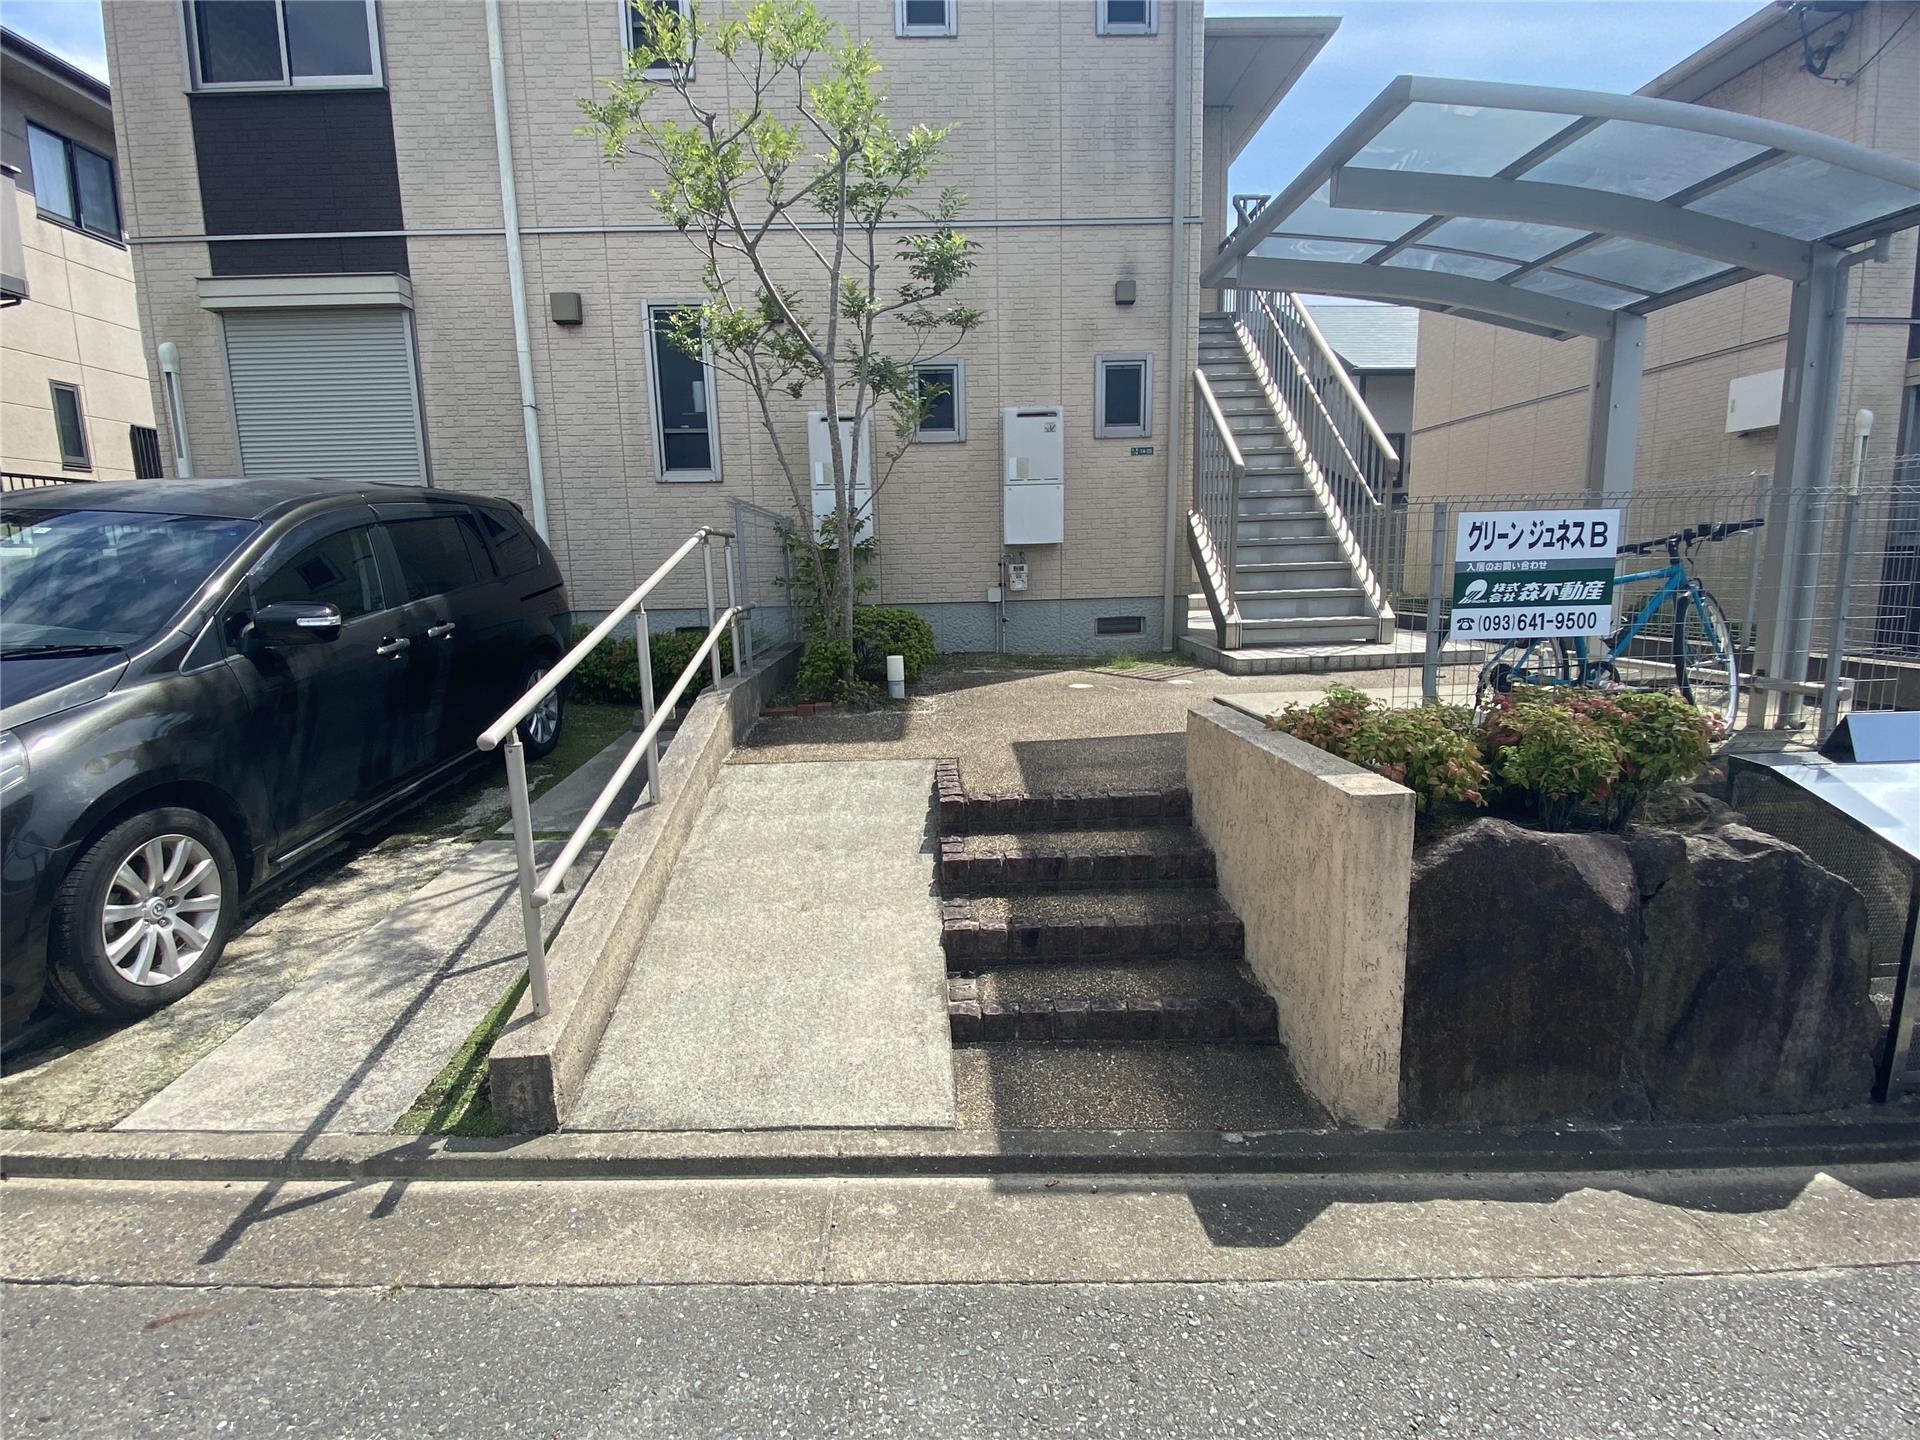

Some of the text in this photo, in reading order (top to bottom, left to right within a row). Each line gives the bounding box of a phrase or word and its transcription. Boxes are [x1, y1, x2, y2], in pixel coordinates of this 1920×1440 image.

[1518, 580, 1606, 602] 森不動産
[1478, 611, 1597, 632] (093)641-9500
